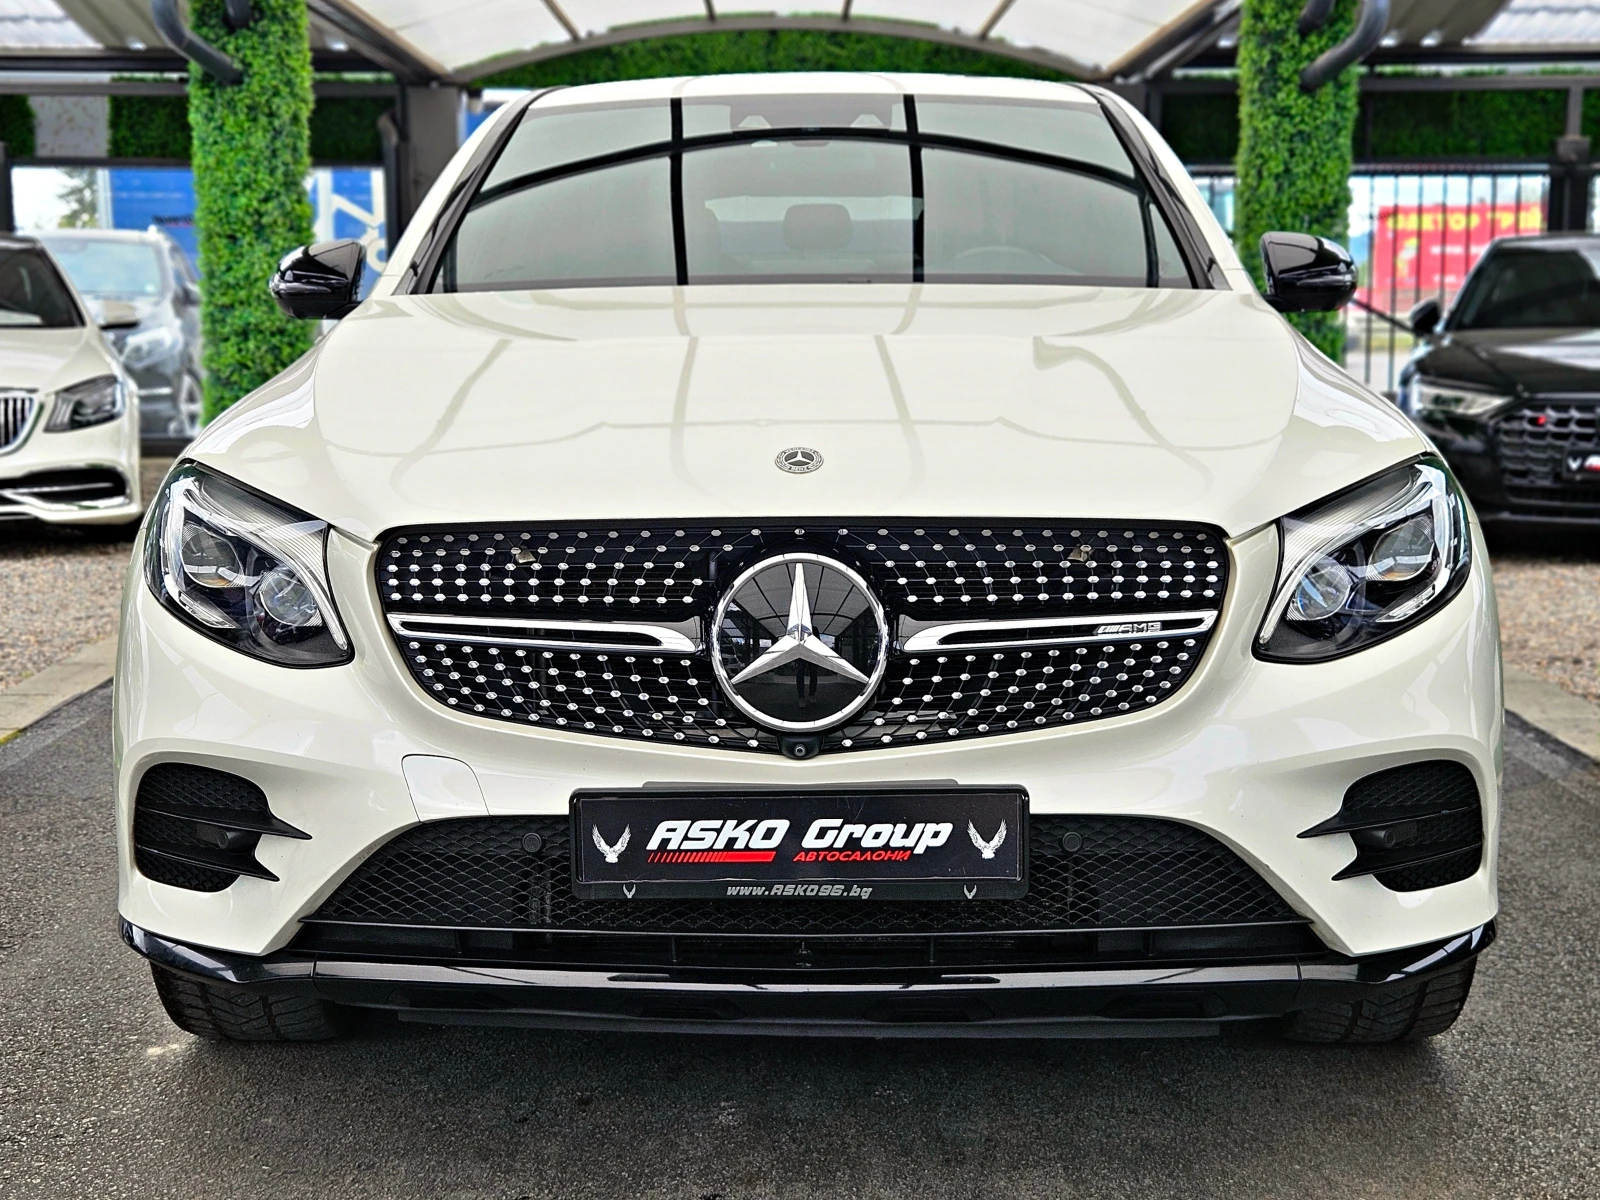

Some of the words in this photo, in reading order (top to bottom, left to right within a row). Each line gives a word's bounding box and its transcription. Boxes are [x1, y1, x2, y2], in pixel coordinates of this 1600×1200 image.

[646, 819, 790, 850] ASKO
[801, 818, 954, 854] Group
[793, 850, 912, 862] АВТОСАЛОНИ
[726, 884, 873, 900] www.ASKO96.bg
